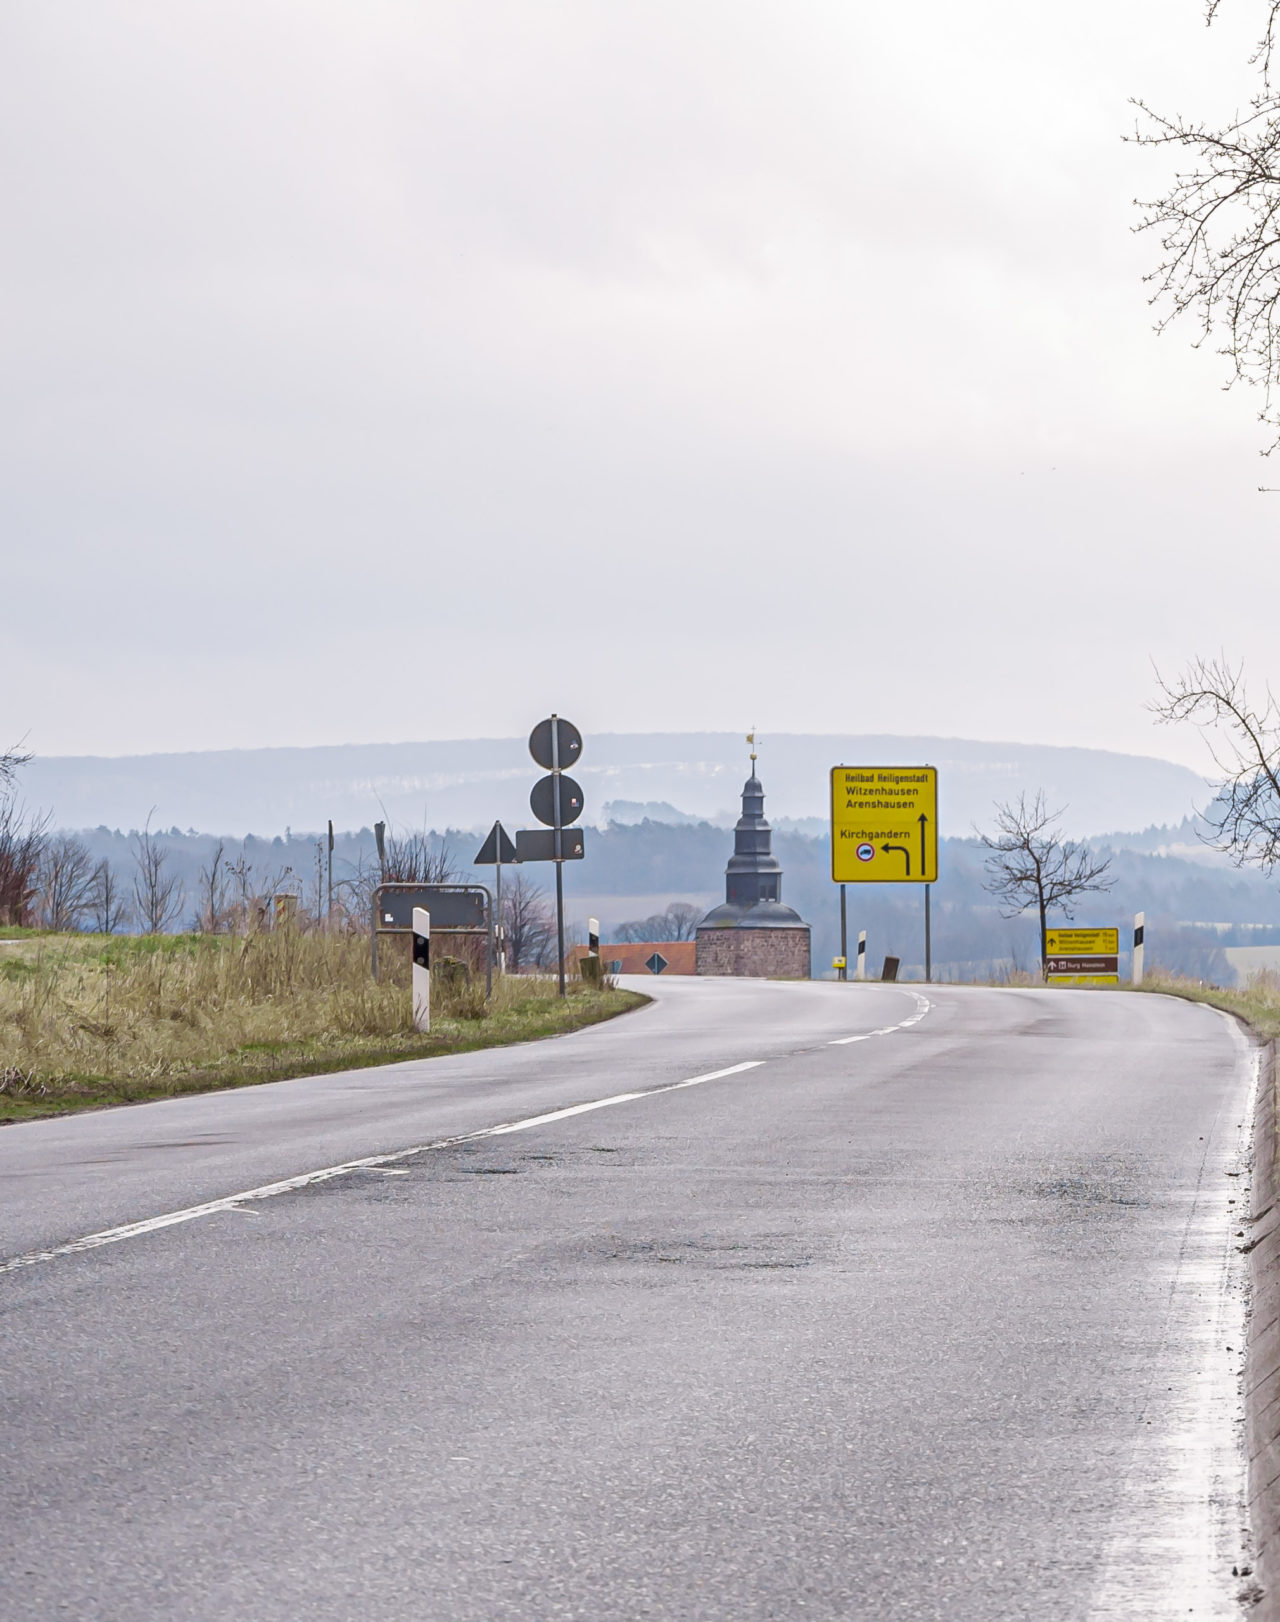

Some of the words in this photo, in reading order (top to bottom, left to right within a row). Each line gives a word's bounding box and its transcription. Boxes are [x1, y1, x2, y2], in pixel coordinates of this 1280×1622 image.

[845, 773, 874, 782] Heilbad
[877, 773, 928, 785] Heiligenstadt
[846, 786, 918, 796] Witzenhausen
[846, 799, 914, 809] Arenshausen
[840, 829, 910, 841] Kirchgandern
